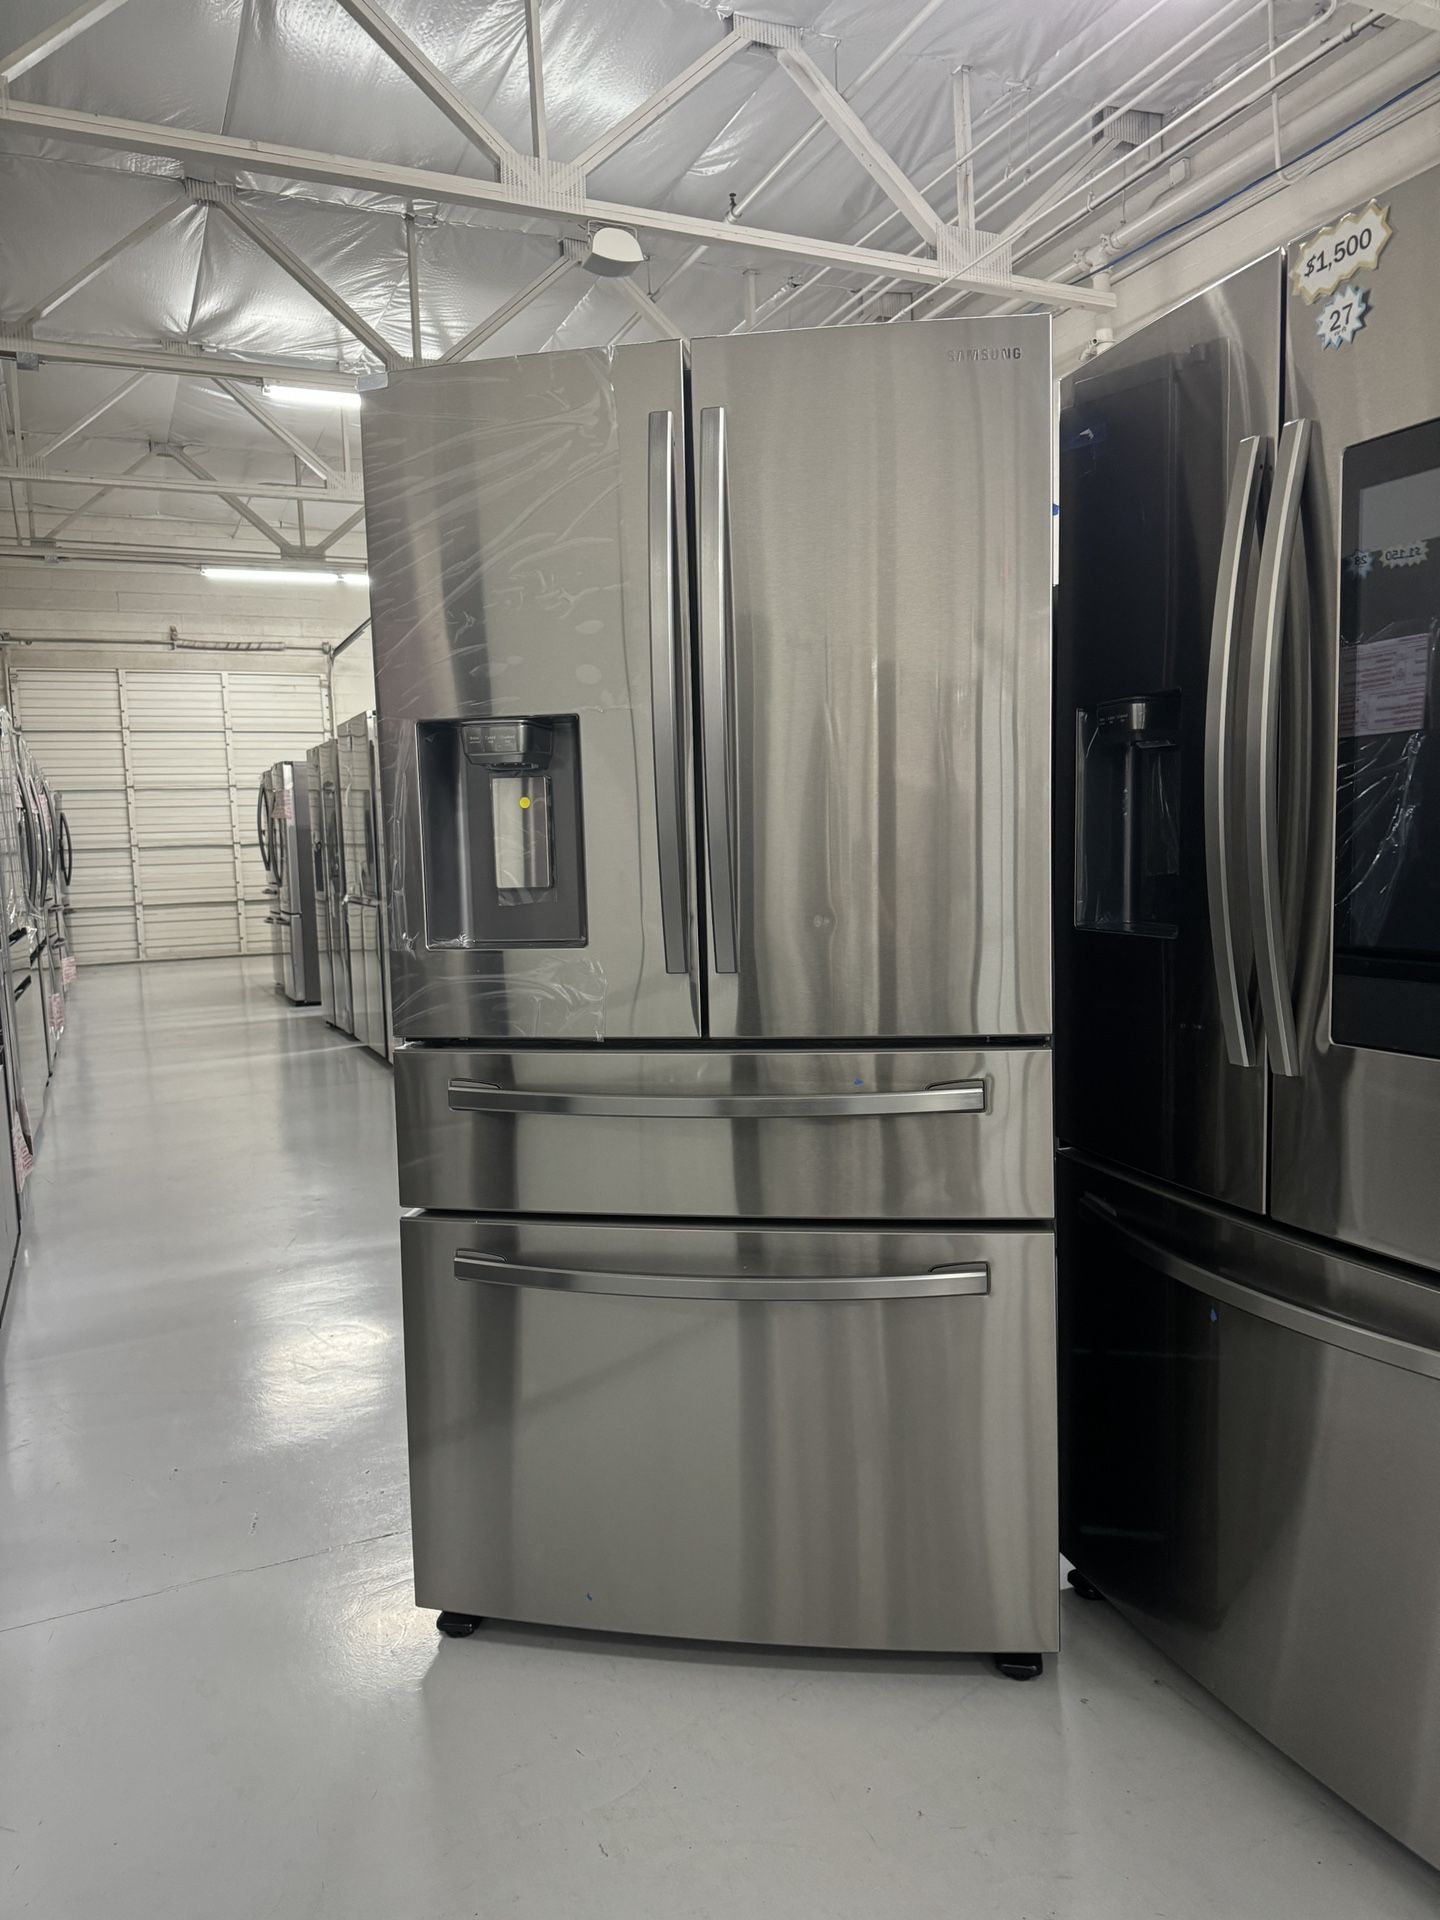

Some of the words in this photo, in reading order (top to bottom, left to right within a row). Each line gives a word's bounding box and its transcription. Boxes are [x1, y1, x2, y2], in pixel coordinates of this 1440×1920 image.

[1304, 228, 1372, 278] $1,500
[1329, 302, 1353, 332] 27
[947, 347, 1022, 361] SAMSUNG
